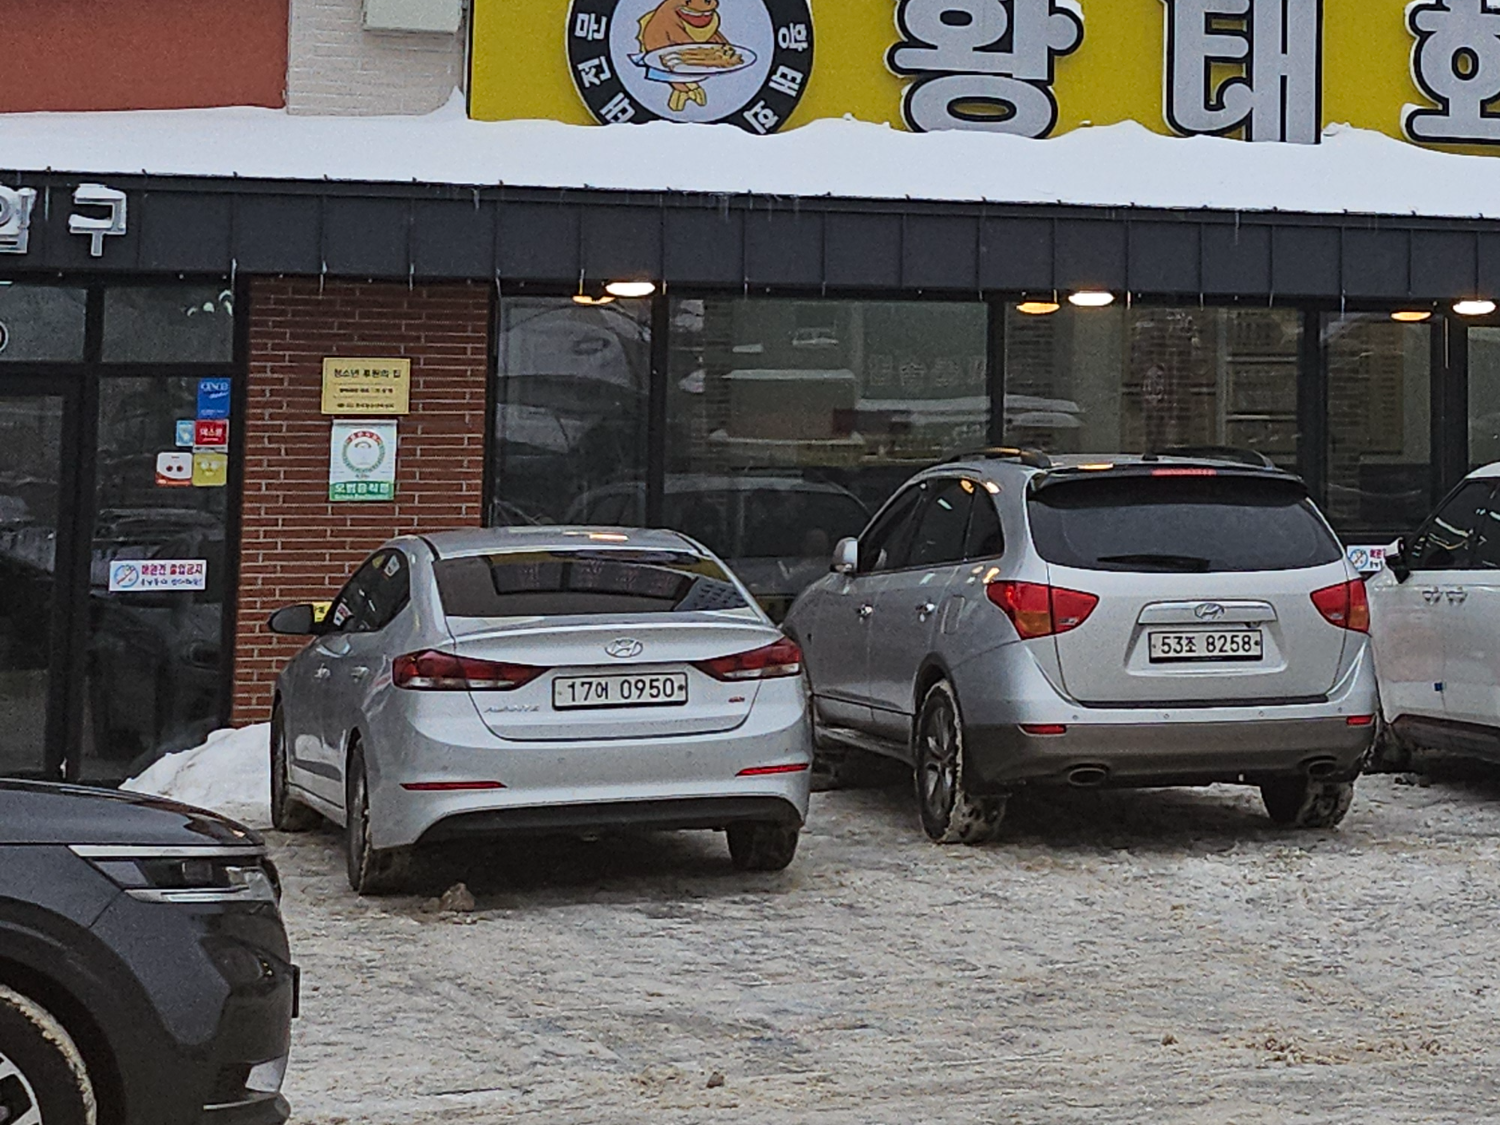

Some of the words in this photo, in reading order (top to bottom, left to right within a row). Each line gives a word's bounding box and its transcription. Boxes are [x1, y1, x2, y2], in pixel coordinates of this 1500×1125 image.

[1161, 635, 1197, 655] 53조
[1206, 634, 1252, 653] 8258
[620, 678, 676, 700] 0950
